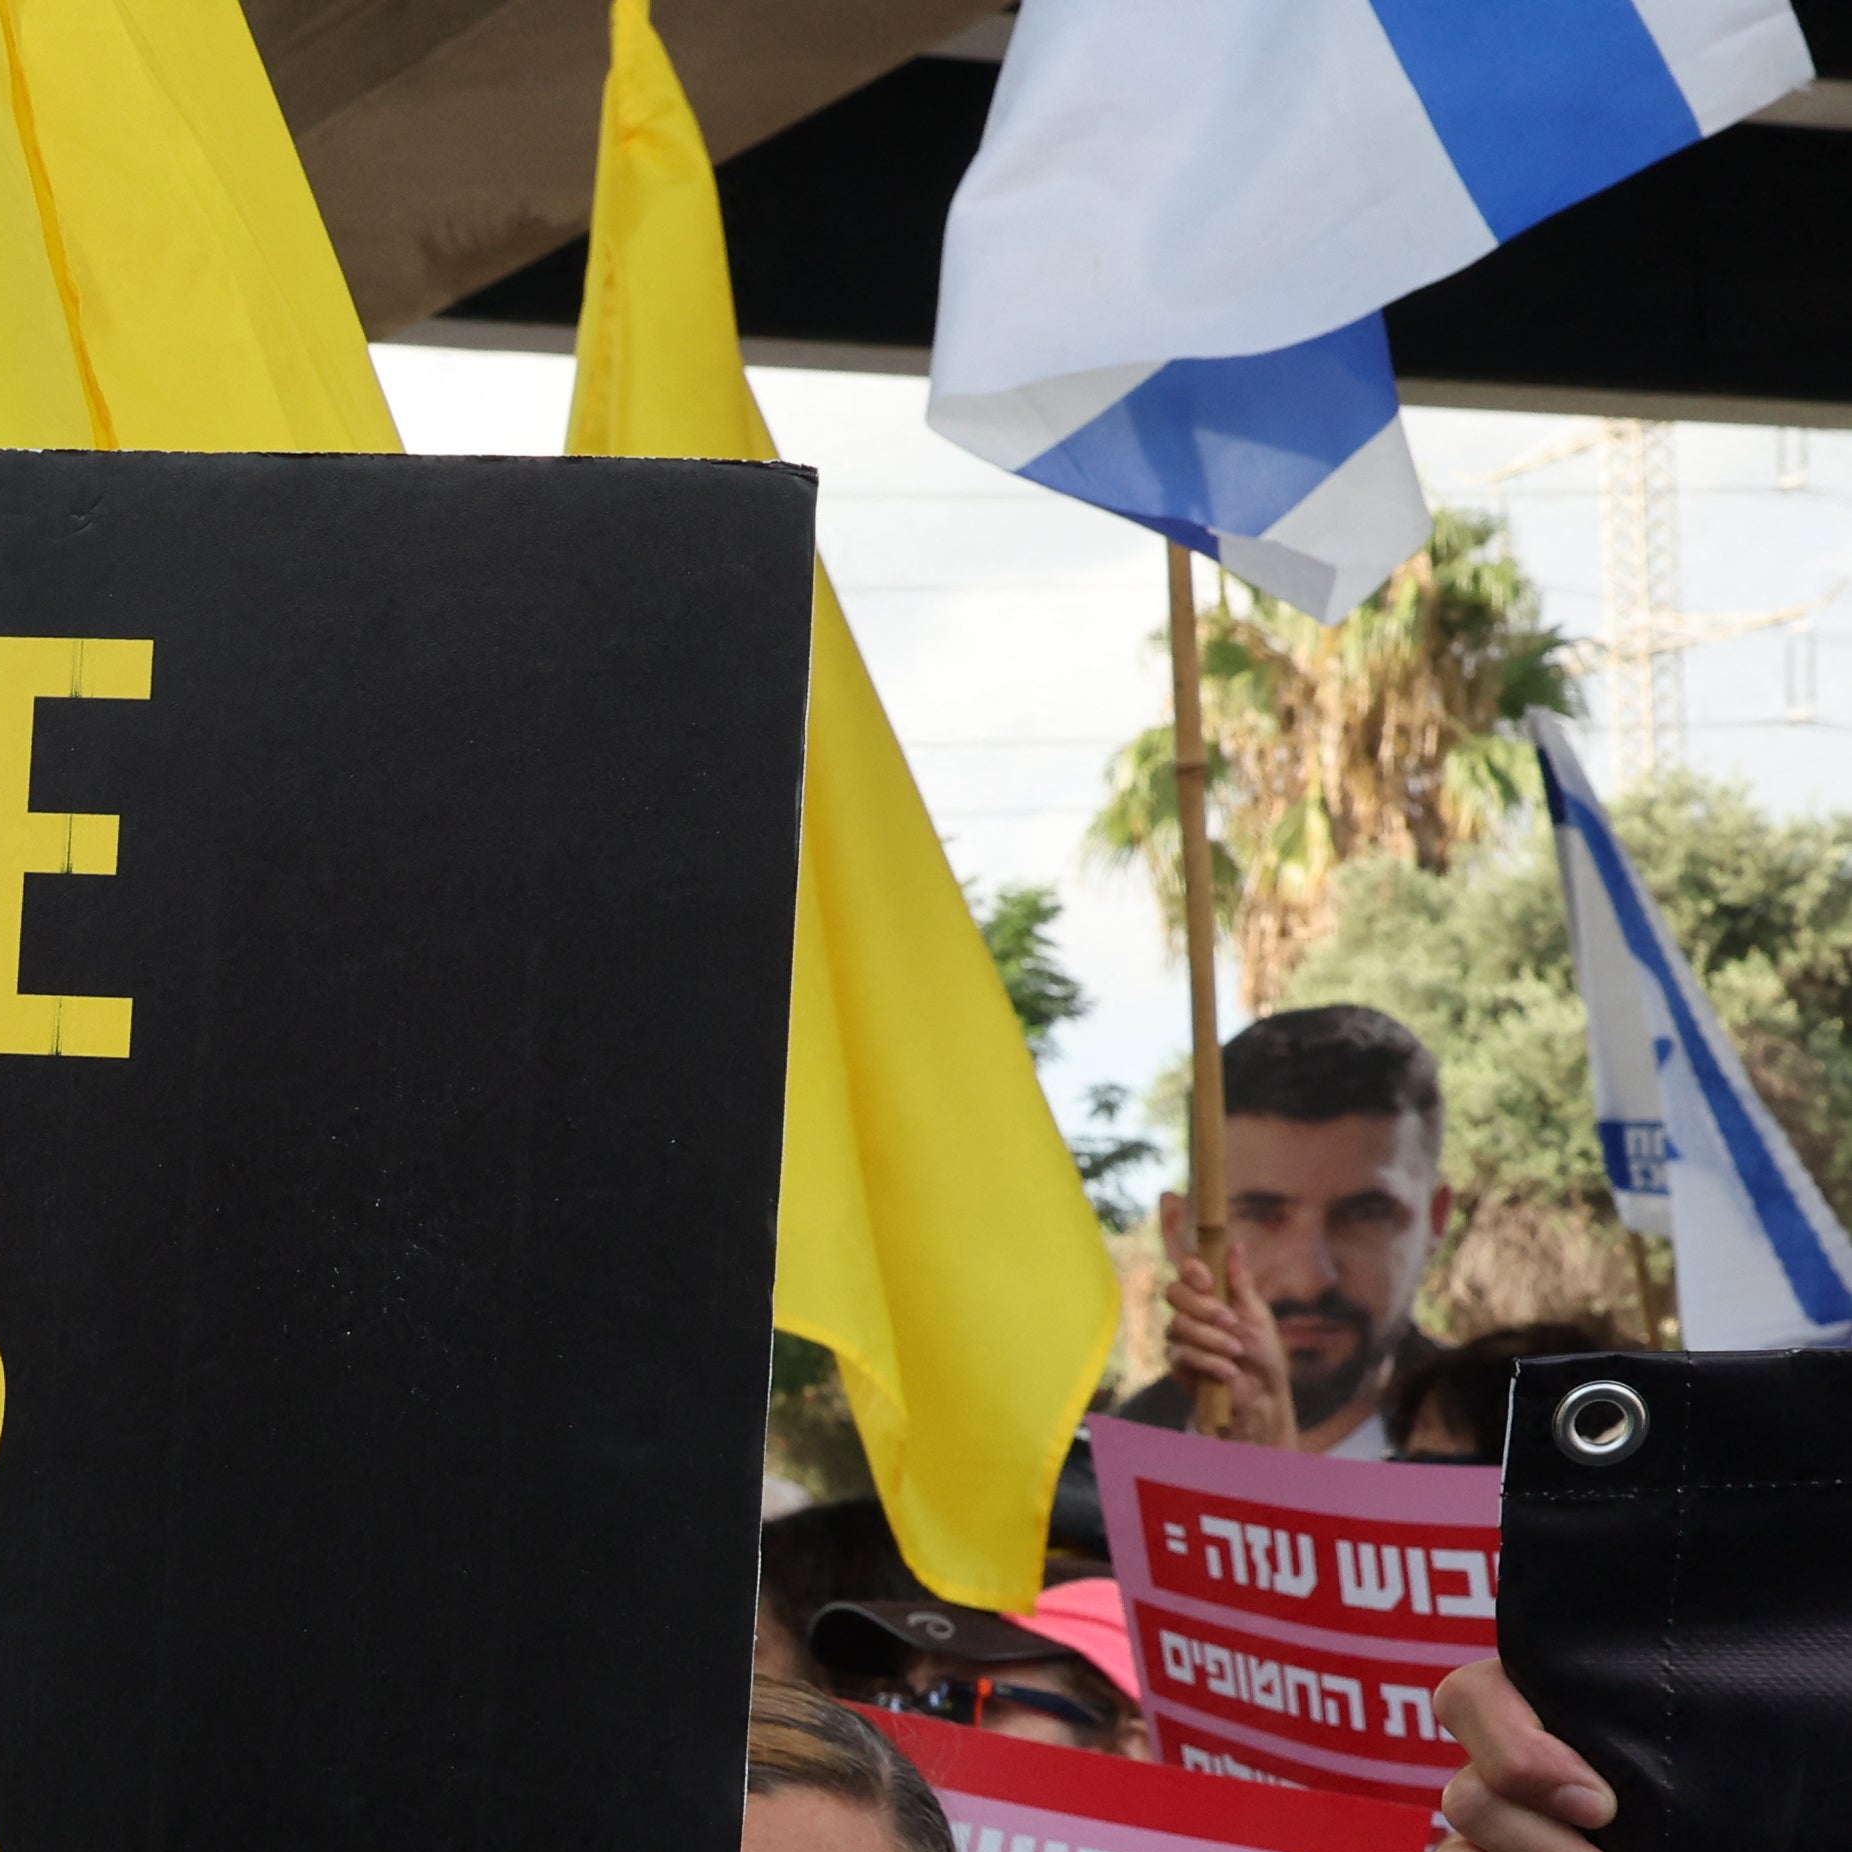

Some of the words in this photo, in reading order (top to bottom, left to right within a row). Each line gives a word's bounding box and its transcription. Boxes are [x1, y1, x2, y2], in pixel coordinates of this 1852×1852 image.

[1199, 1514, 1318, 1598] עזה
[1335, 1539, 1501, 1619] בוש
[1159, 1629, 1367, 1732] החטופים
